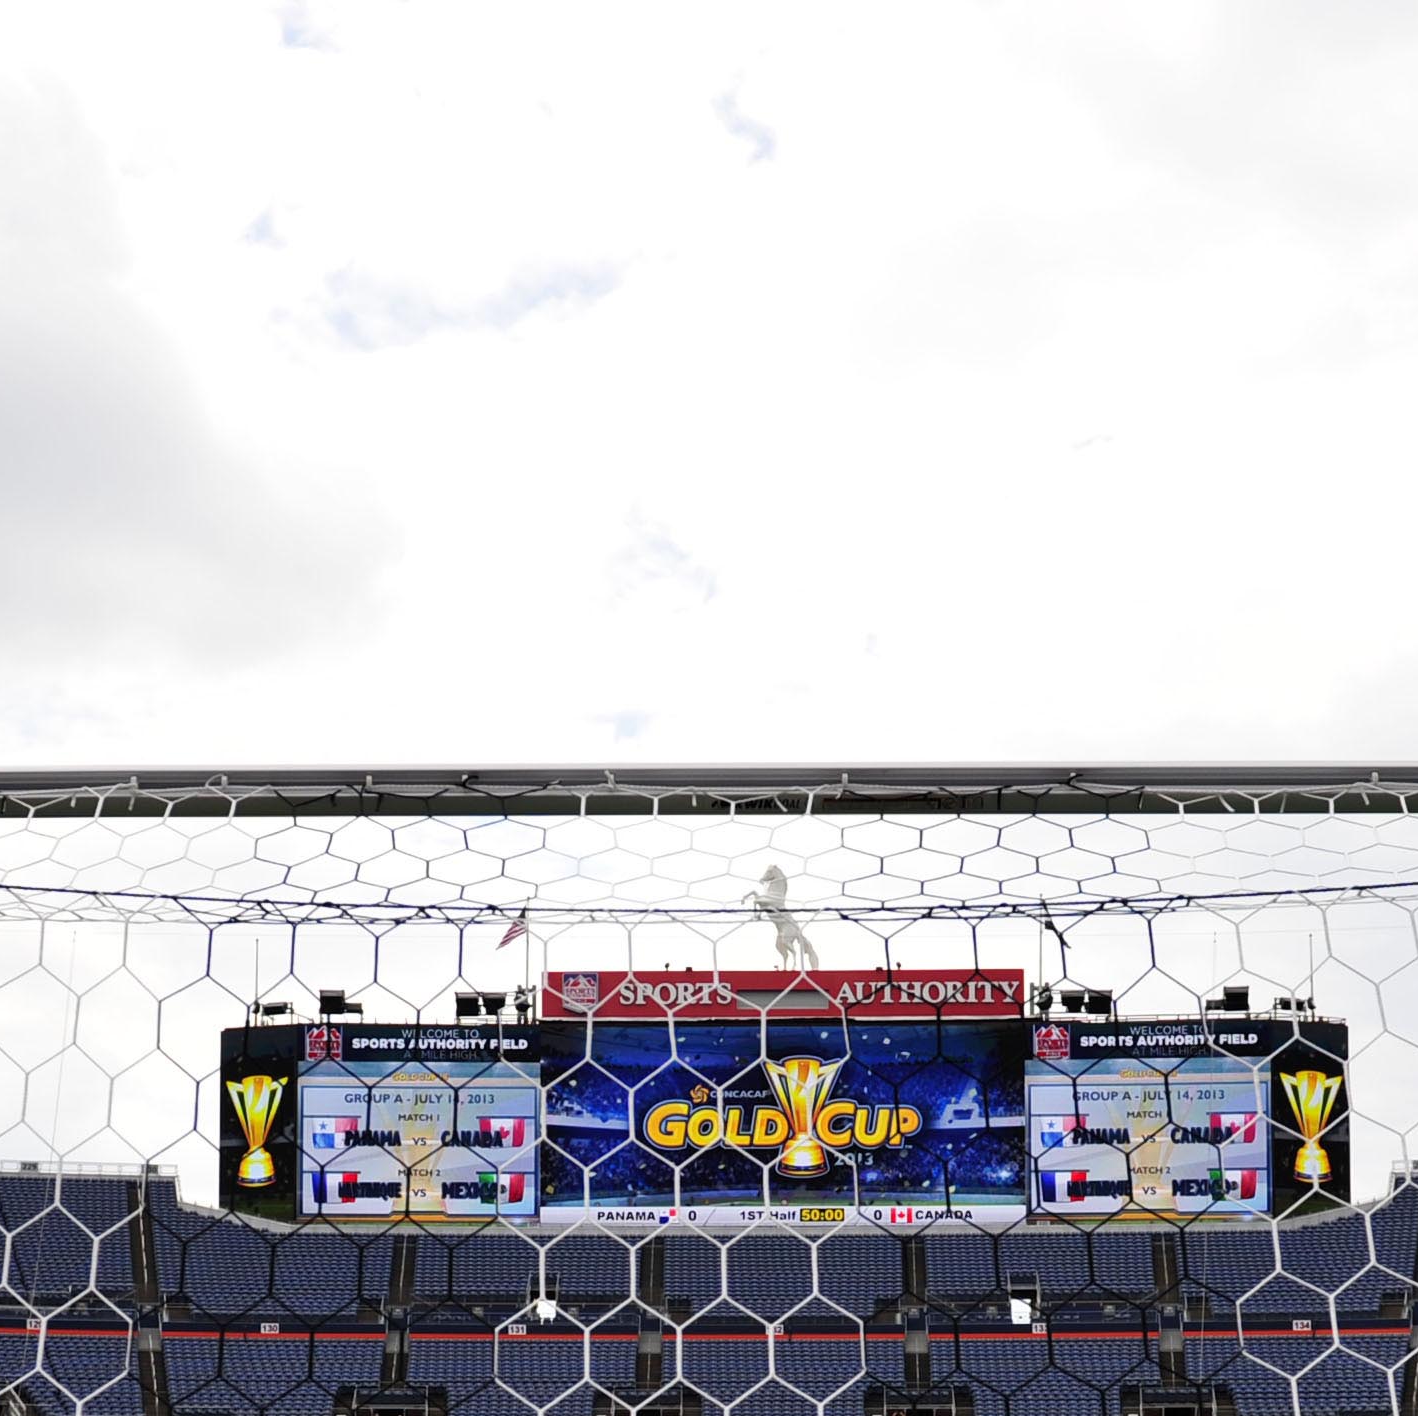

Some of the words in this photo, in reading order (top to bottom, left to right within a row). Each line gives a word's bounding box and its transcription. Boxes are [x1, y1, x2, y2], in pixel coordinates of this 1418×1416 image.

[620, 982, 732, 1005] SPORTS
[835, 981, 1020, 1004] AUTHORITY
[464, 1028, 480, 1039] TO
[1130, 1025, 1188, 1035] WELCOME
[352, 1038, 405, 1050] SPORTS
[489, 1038, 529, 1050] FELD
[1219, 1033, 1258, 1045] FIELD
[394, 1094, 404, 1104] A
[414, 1093, 443, 1106] JULY
[448, 1093, 464, 1106] 1,
[467, 1093, 495, 1104] 2013
[1122, 1091, 1132, 1101] A
[1197, 1089, 1225, 1100] 2013
[398, 1114, 433, 1122] MATCH
[1127, 1111, 1163, 1119] MATCH
[646, 1100, 789, 1147] GOLD
[815, 1100, 920, 1147] CUP
[412, 1138, 427, 1146] VS
[412, 1189, 427, 1197] VS
[1141, 1186, 1157, 1195] VS
[597, 1211, 656, 1221] PANAMA
[688, 1210, 697, 1221] 0
[739, 1210, 765, 1220] 1ST
[801, 1208, 844, 1222] 50:00
[873, 1209, 883, 1221] 0
[915, 1210, 973, 1220] CANADA
[263, 1324, 278, 1333] 130
[510, 1325, 525, 1334] 131
[1295, 1321, 1309, 1330] 134
